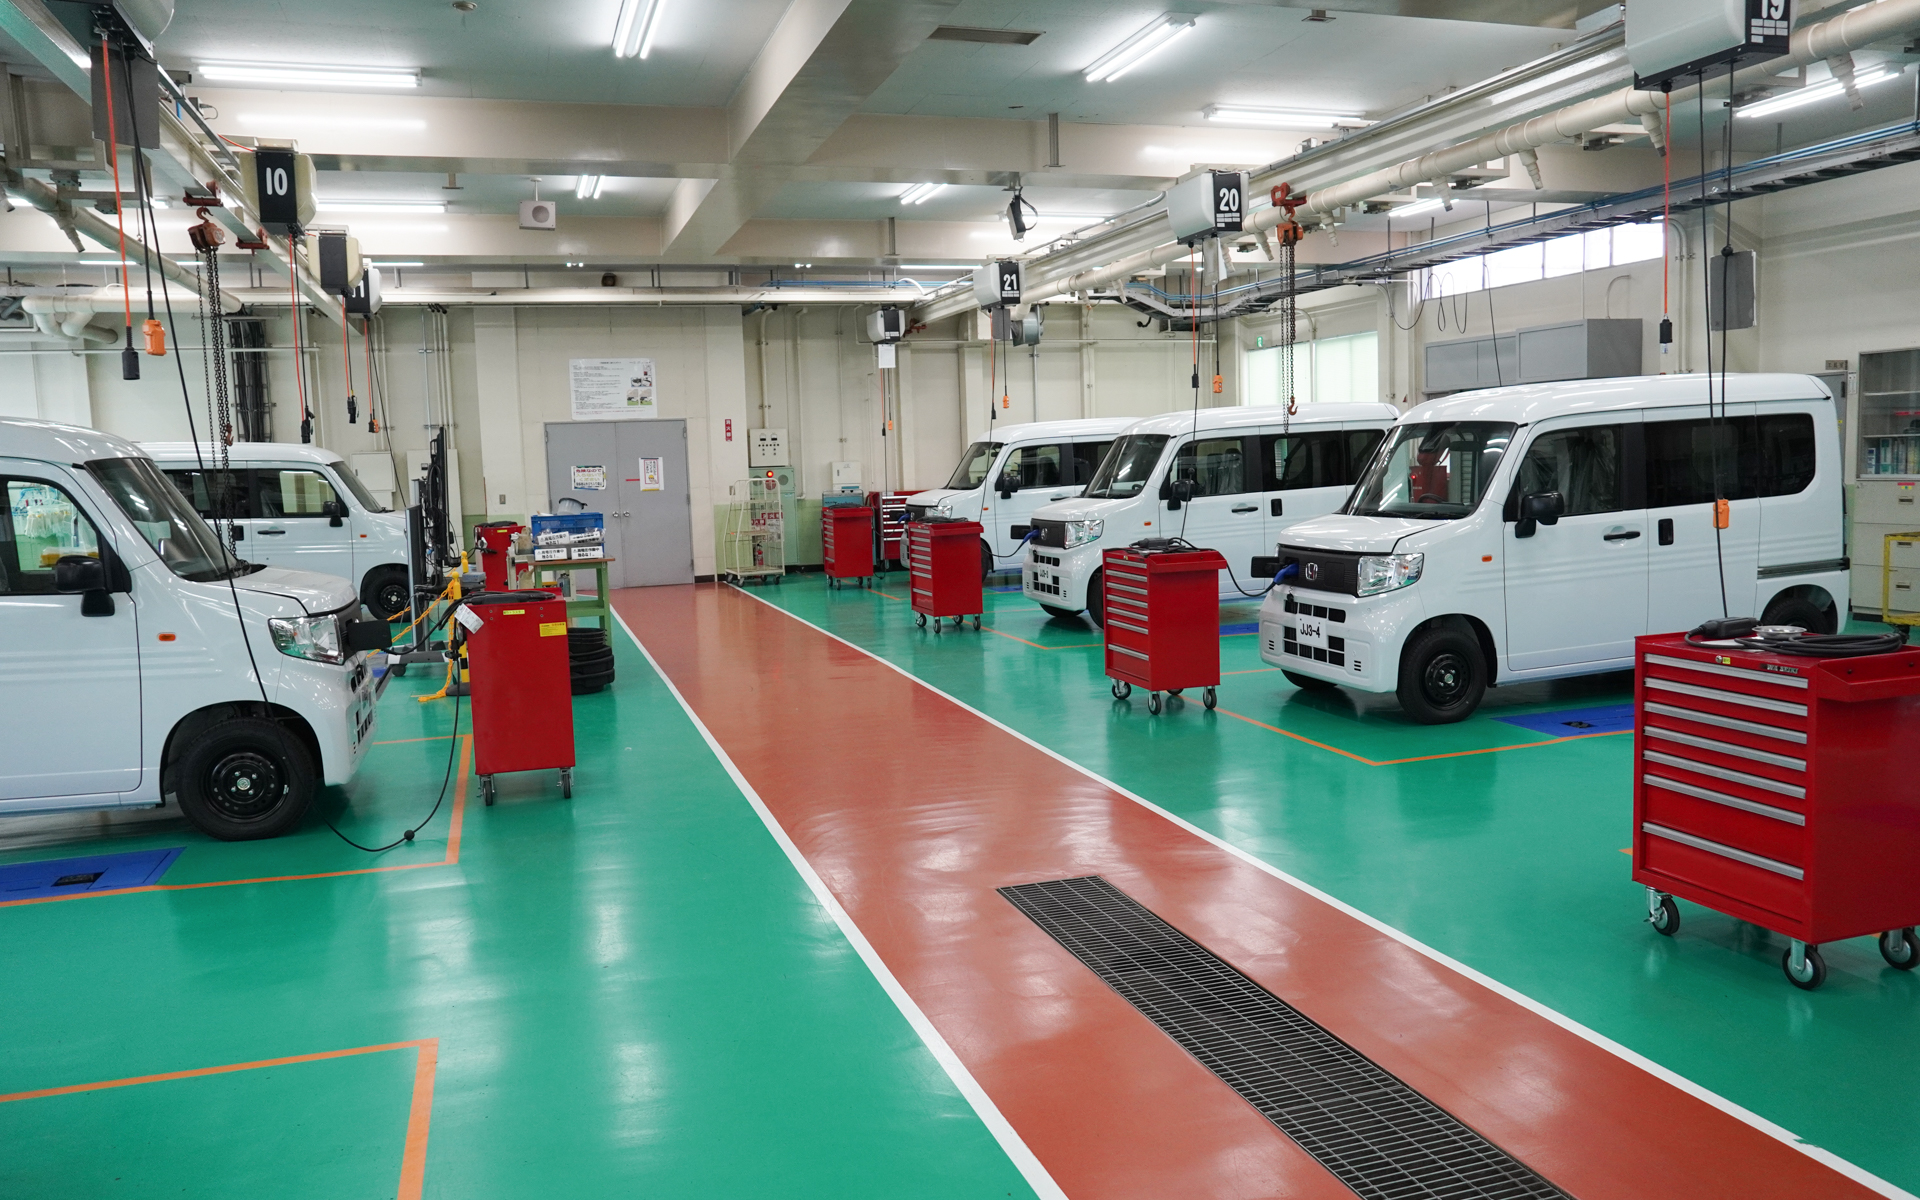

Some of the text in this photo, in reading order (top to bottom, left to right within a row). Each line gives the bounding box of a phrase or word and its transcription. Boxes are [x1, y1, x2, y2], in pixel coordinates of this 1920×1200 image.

[266, 167, 288, 196] 10
[1219, 187, 1239, 212] 20
[1003, 273, 1017, 291] 21
[1300, 622, 1321, 639] JJ3-4
